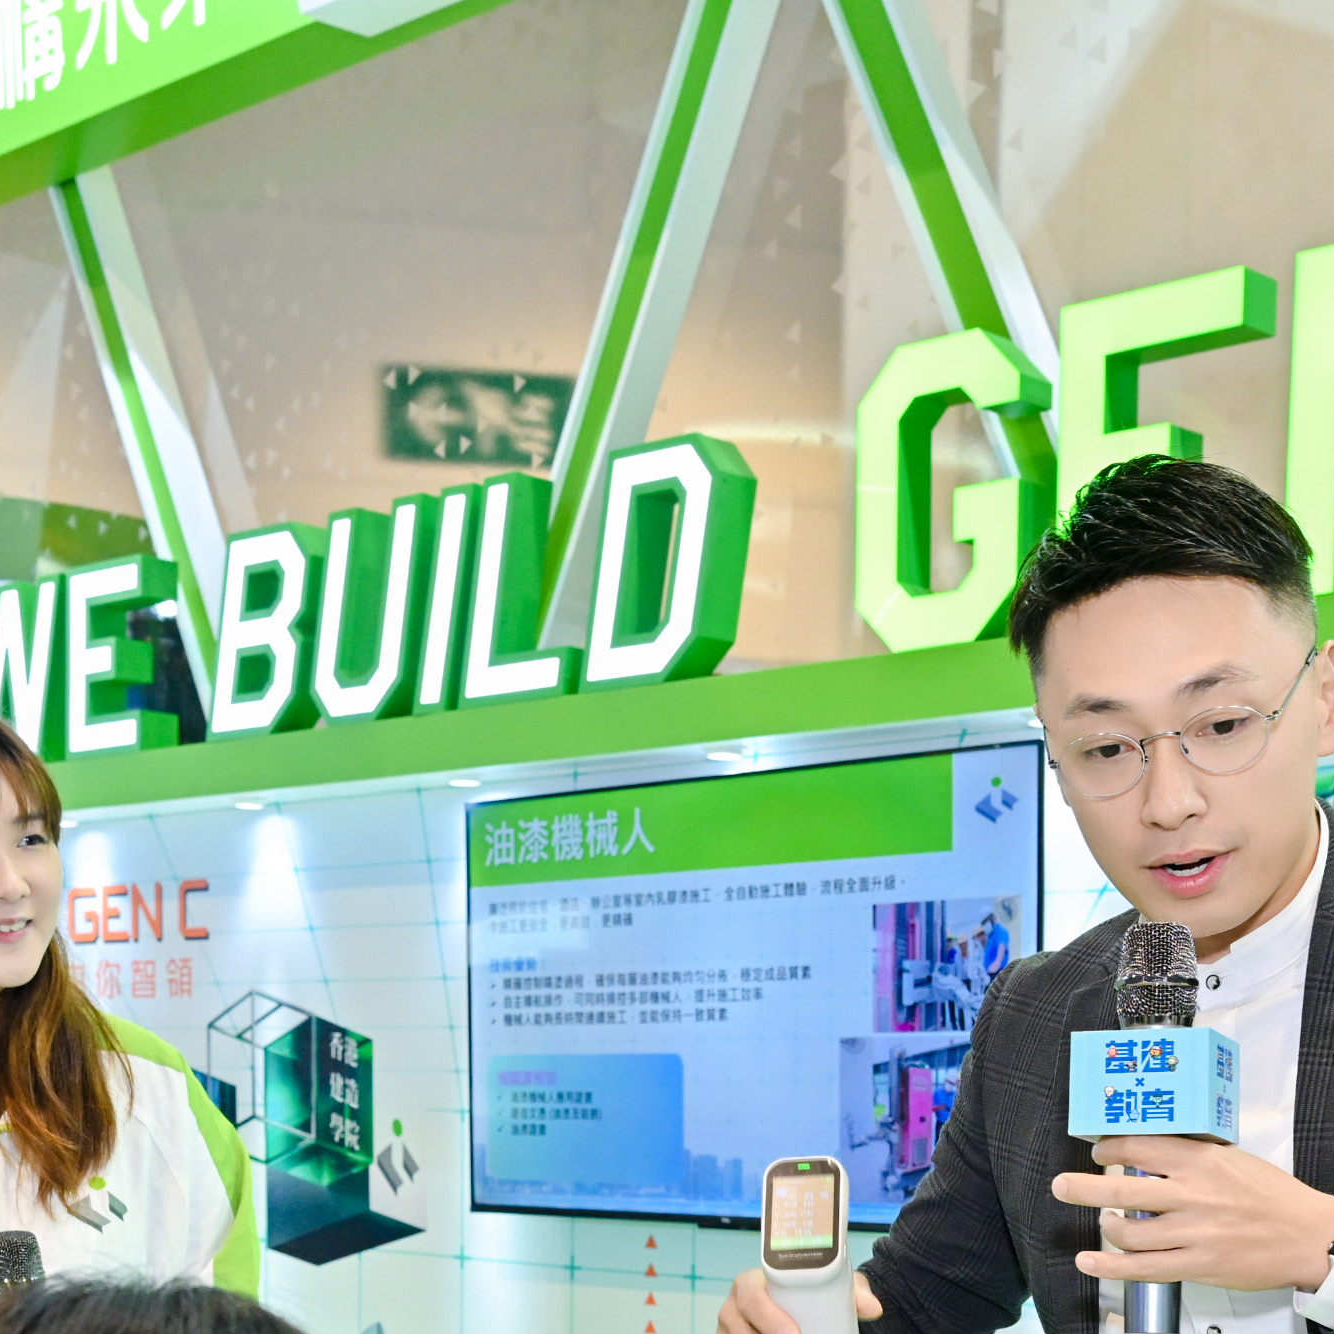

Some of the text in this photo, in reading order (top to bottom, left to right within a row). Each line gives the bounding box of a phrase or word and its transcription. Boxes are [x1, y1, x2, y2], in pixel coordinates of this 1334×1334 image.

[207, 433, 758, 742] BUILD
[484, 806, 655, 868] 油漆機械人
[68, 878, 209, 943] GEN C
[1104, 1088, 1175, 1124] 教育
